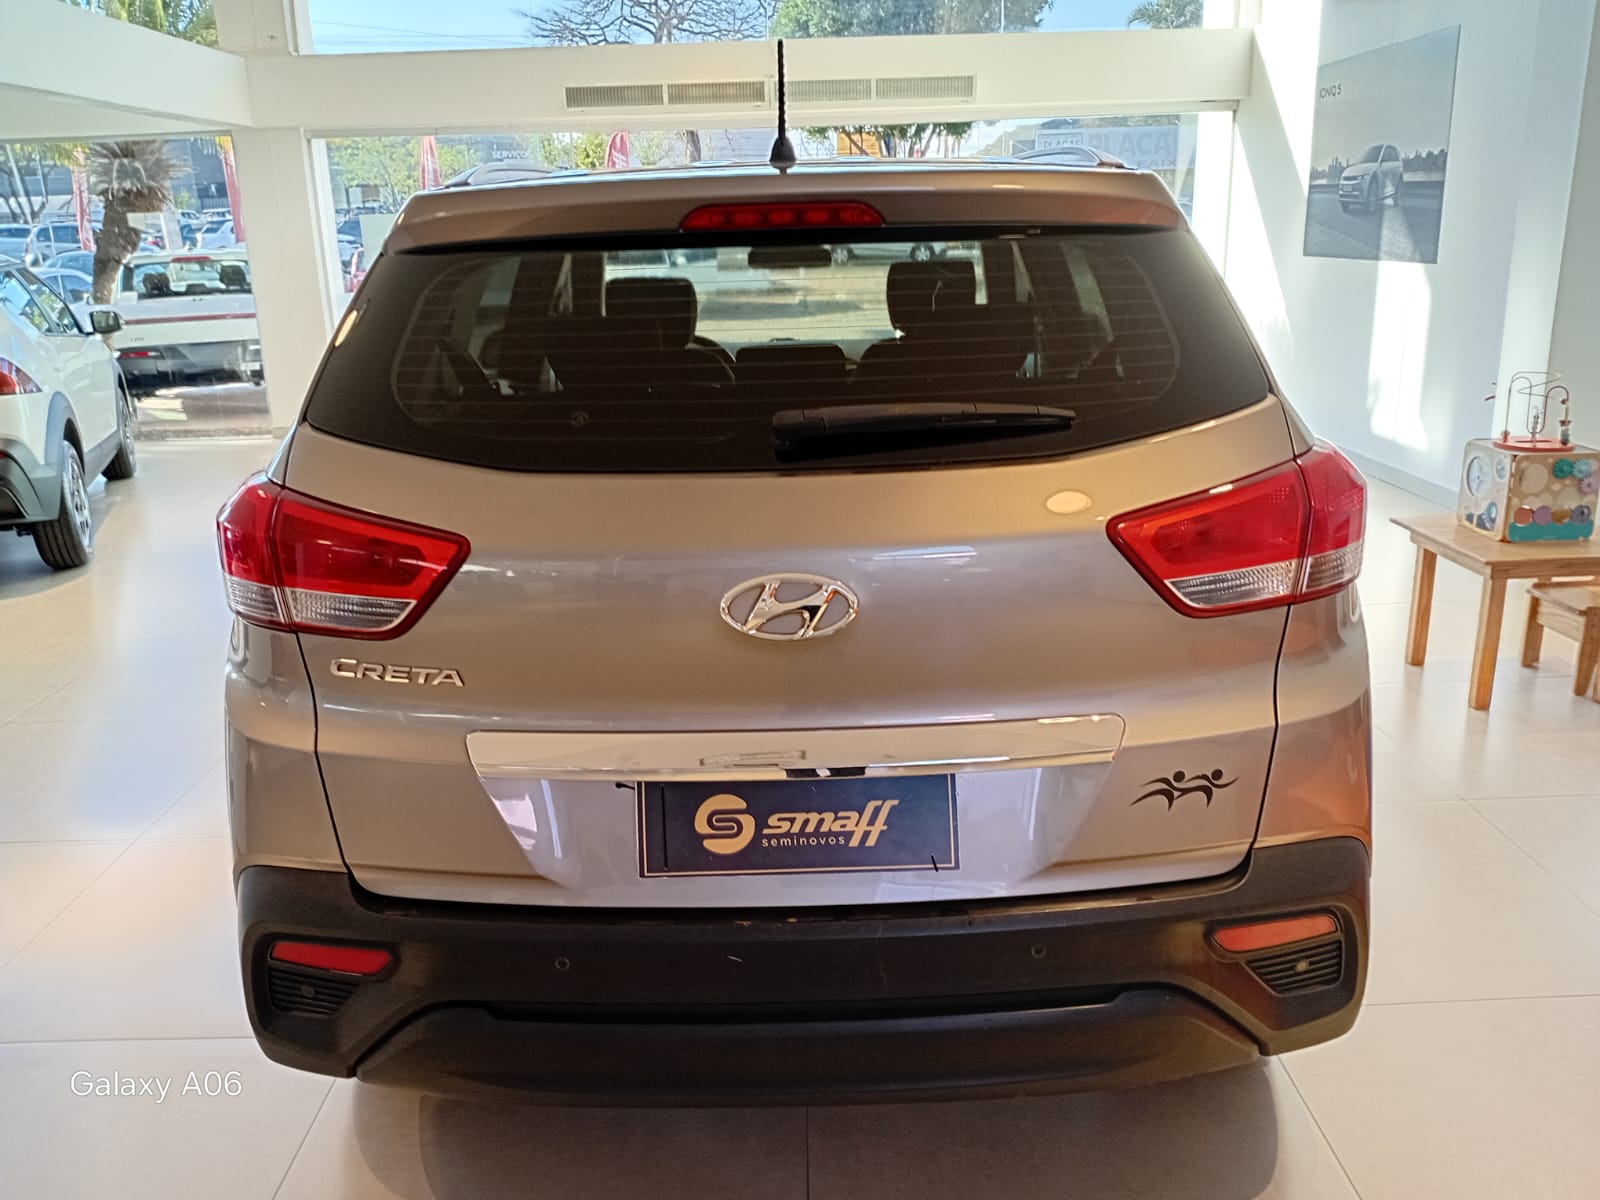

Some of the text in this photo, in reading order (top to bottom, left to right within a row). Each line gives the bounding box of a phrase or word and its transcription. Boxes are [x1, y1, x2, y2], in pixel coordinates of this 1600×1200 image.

[1088, 131, 1172, 157] PLACA
[329, 658, 464, 687] CRETA
[762, 799, 899, 847] smaff
[761, 834, 846, 847] seminovos
